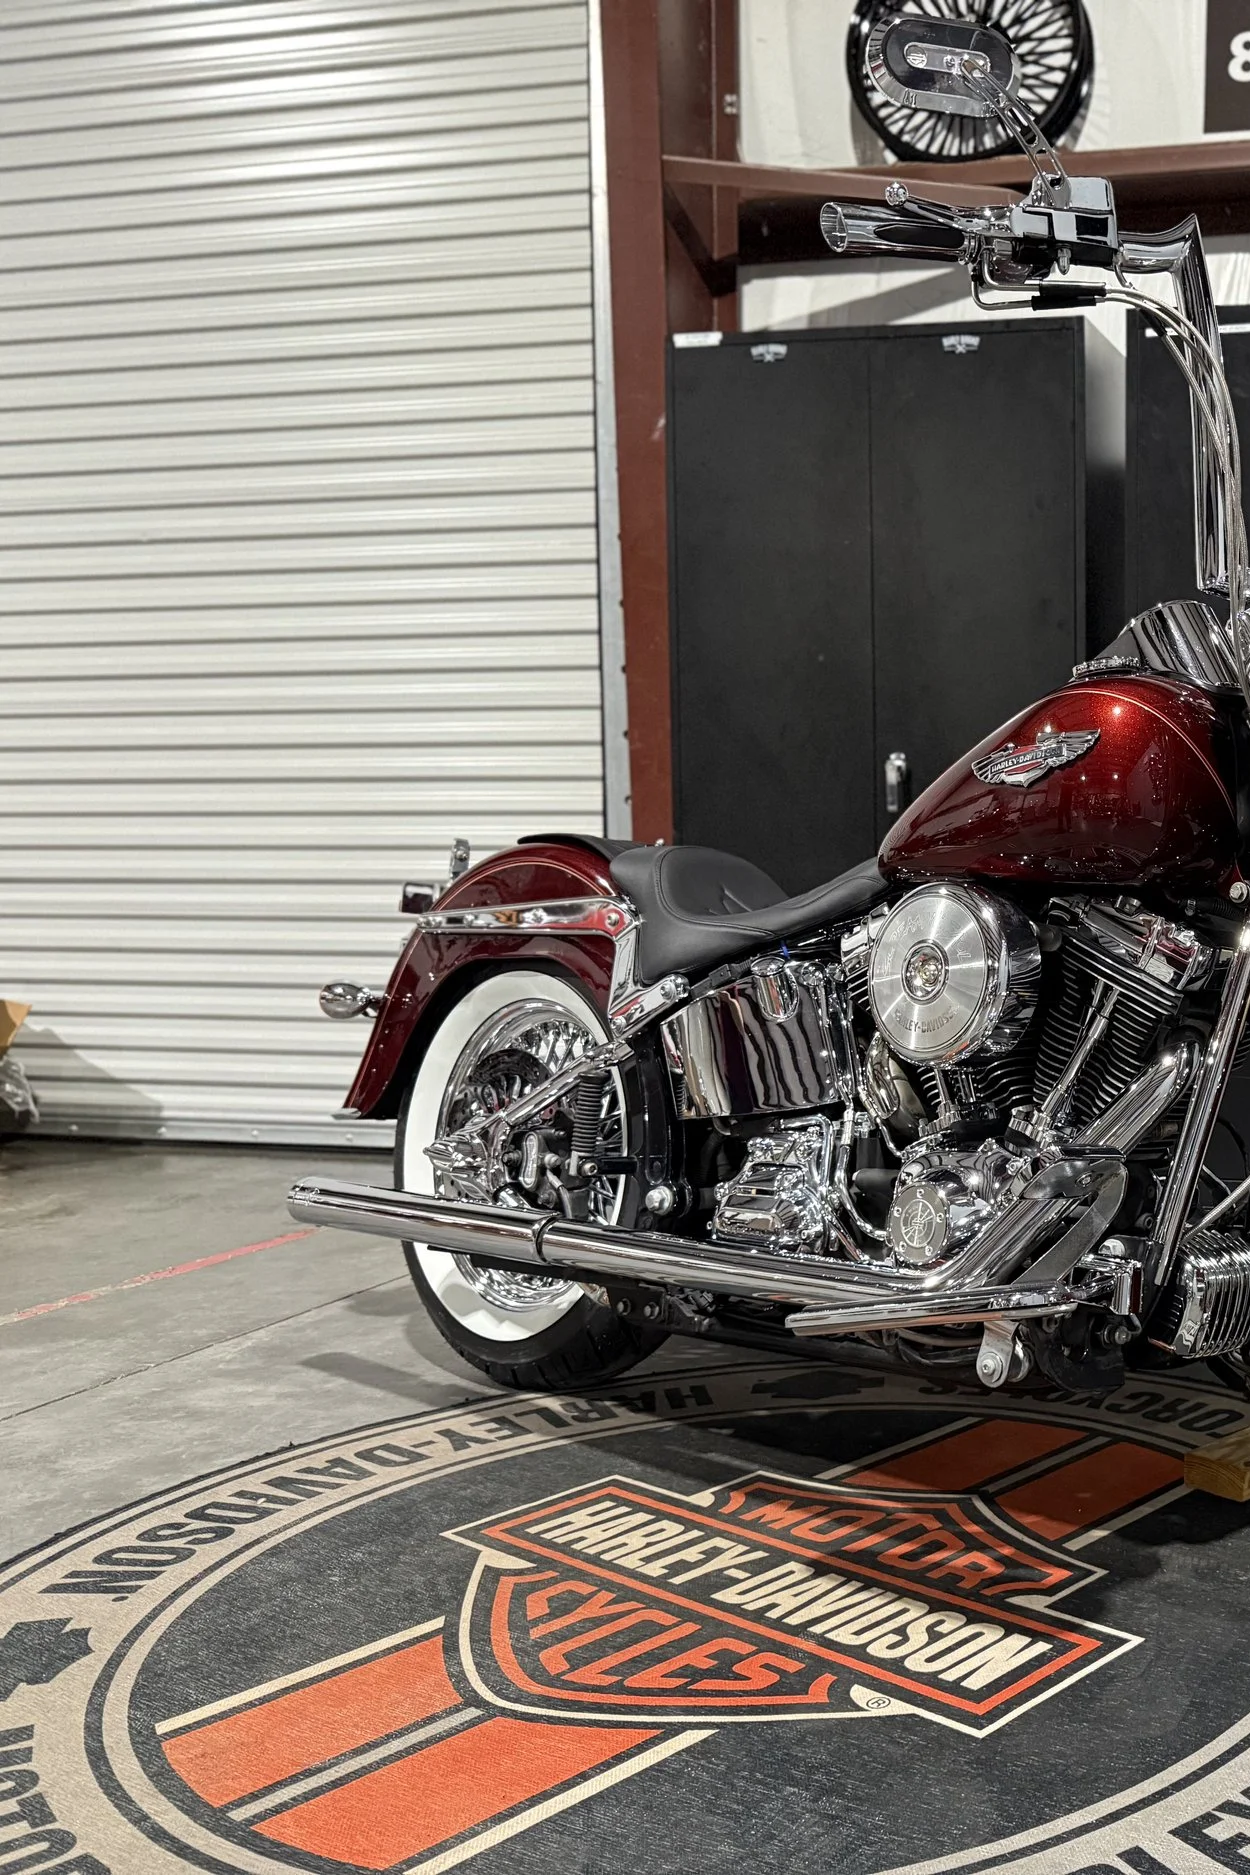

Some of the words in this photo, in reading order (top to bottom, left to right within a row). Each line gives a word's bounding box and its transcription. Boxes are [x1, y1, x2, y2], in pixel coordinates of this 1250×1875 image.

[524, 1500, 1054, 1691] HARLEY-DAVIDSON
[744, 1506, 1007, 1592] MOTOR
[525, 1580, 808, 1690] CYCLES
